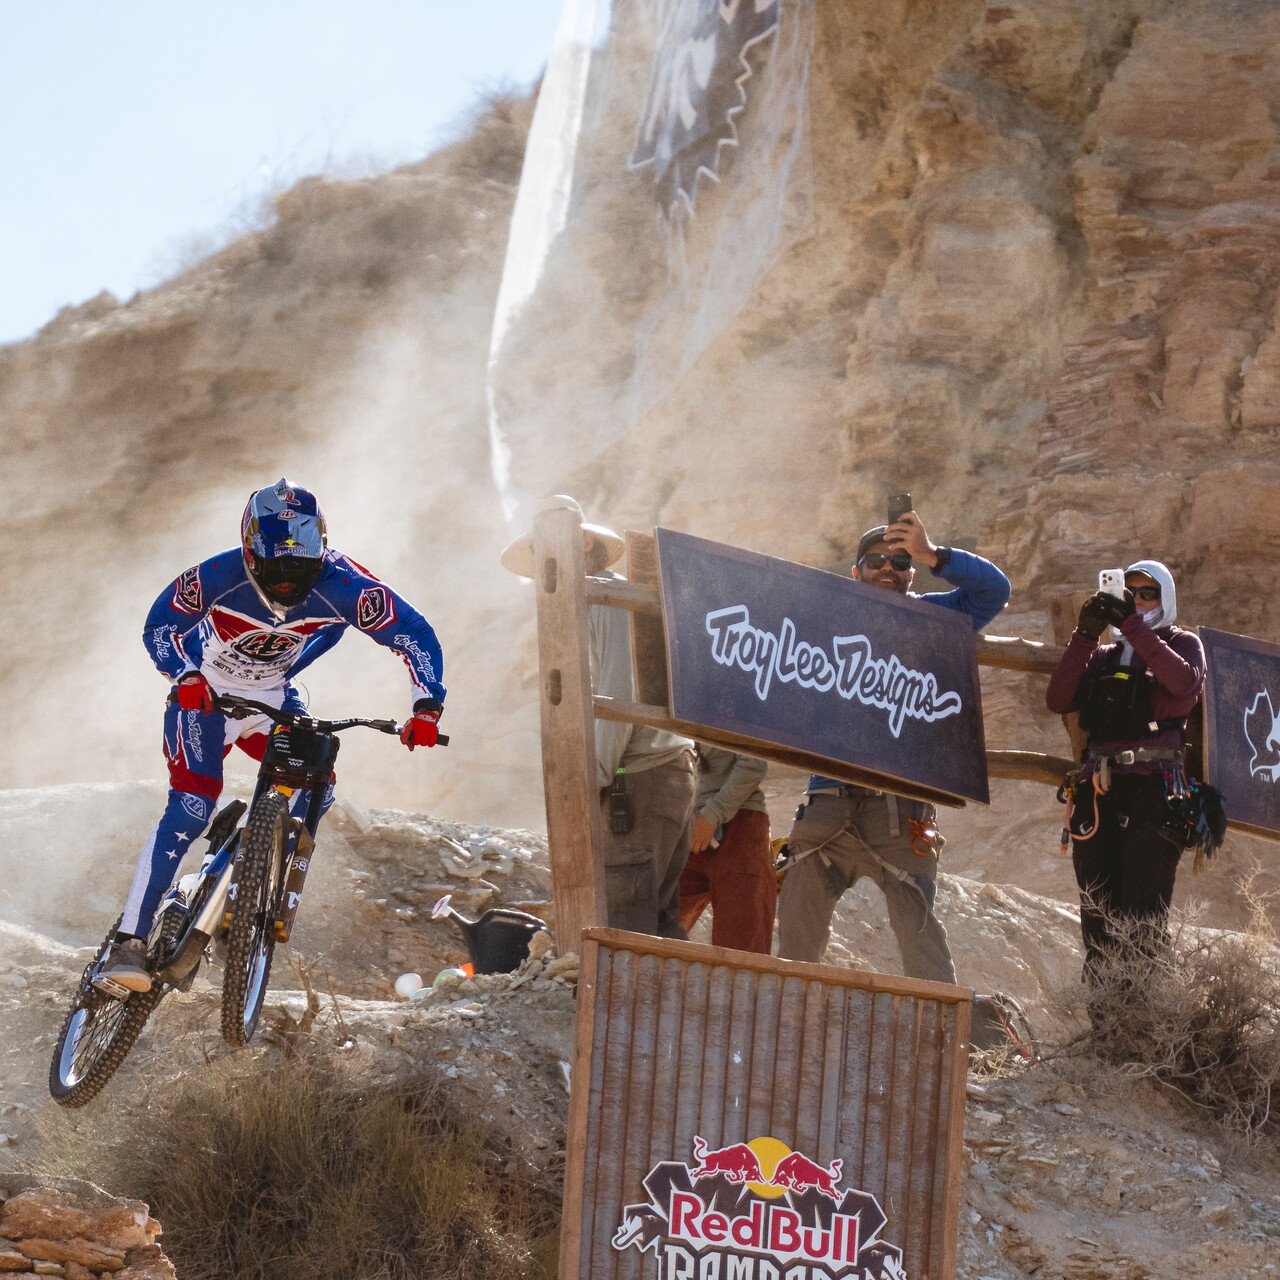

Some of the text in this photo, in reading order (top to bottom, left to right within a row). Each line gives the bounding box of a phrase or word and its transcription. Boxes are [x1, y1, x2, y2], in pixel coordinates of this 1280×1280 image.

[212, 660, 235, 675] DEITY
[706, 604, 963, 738] Troy Lee Designs
[1259, 772, 1271, 783] TM
[291, 860, 307, 872] 58
[670, 1191, 860, 1264] Red Bull
